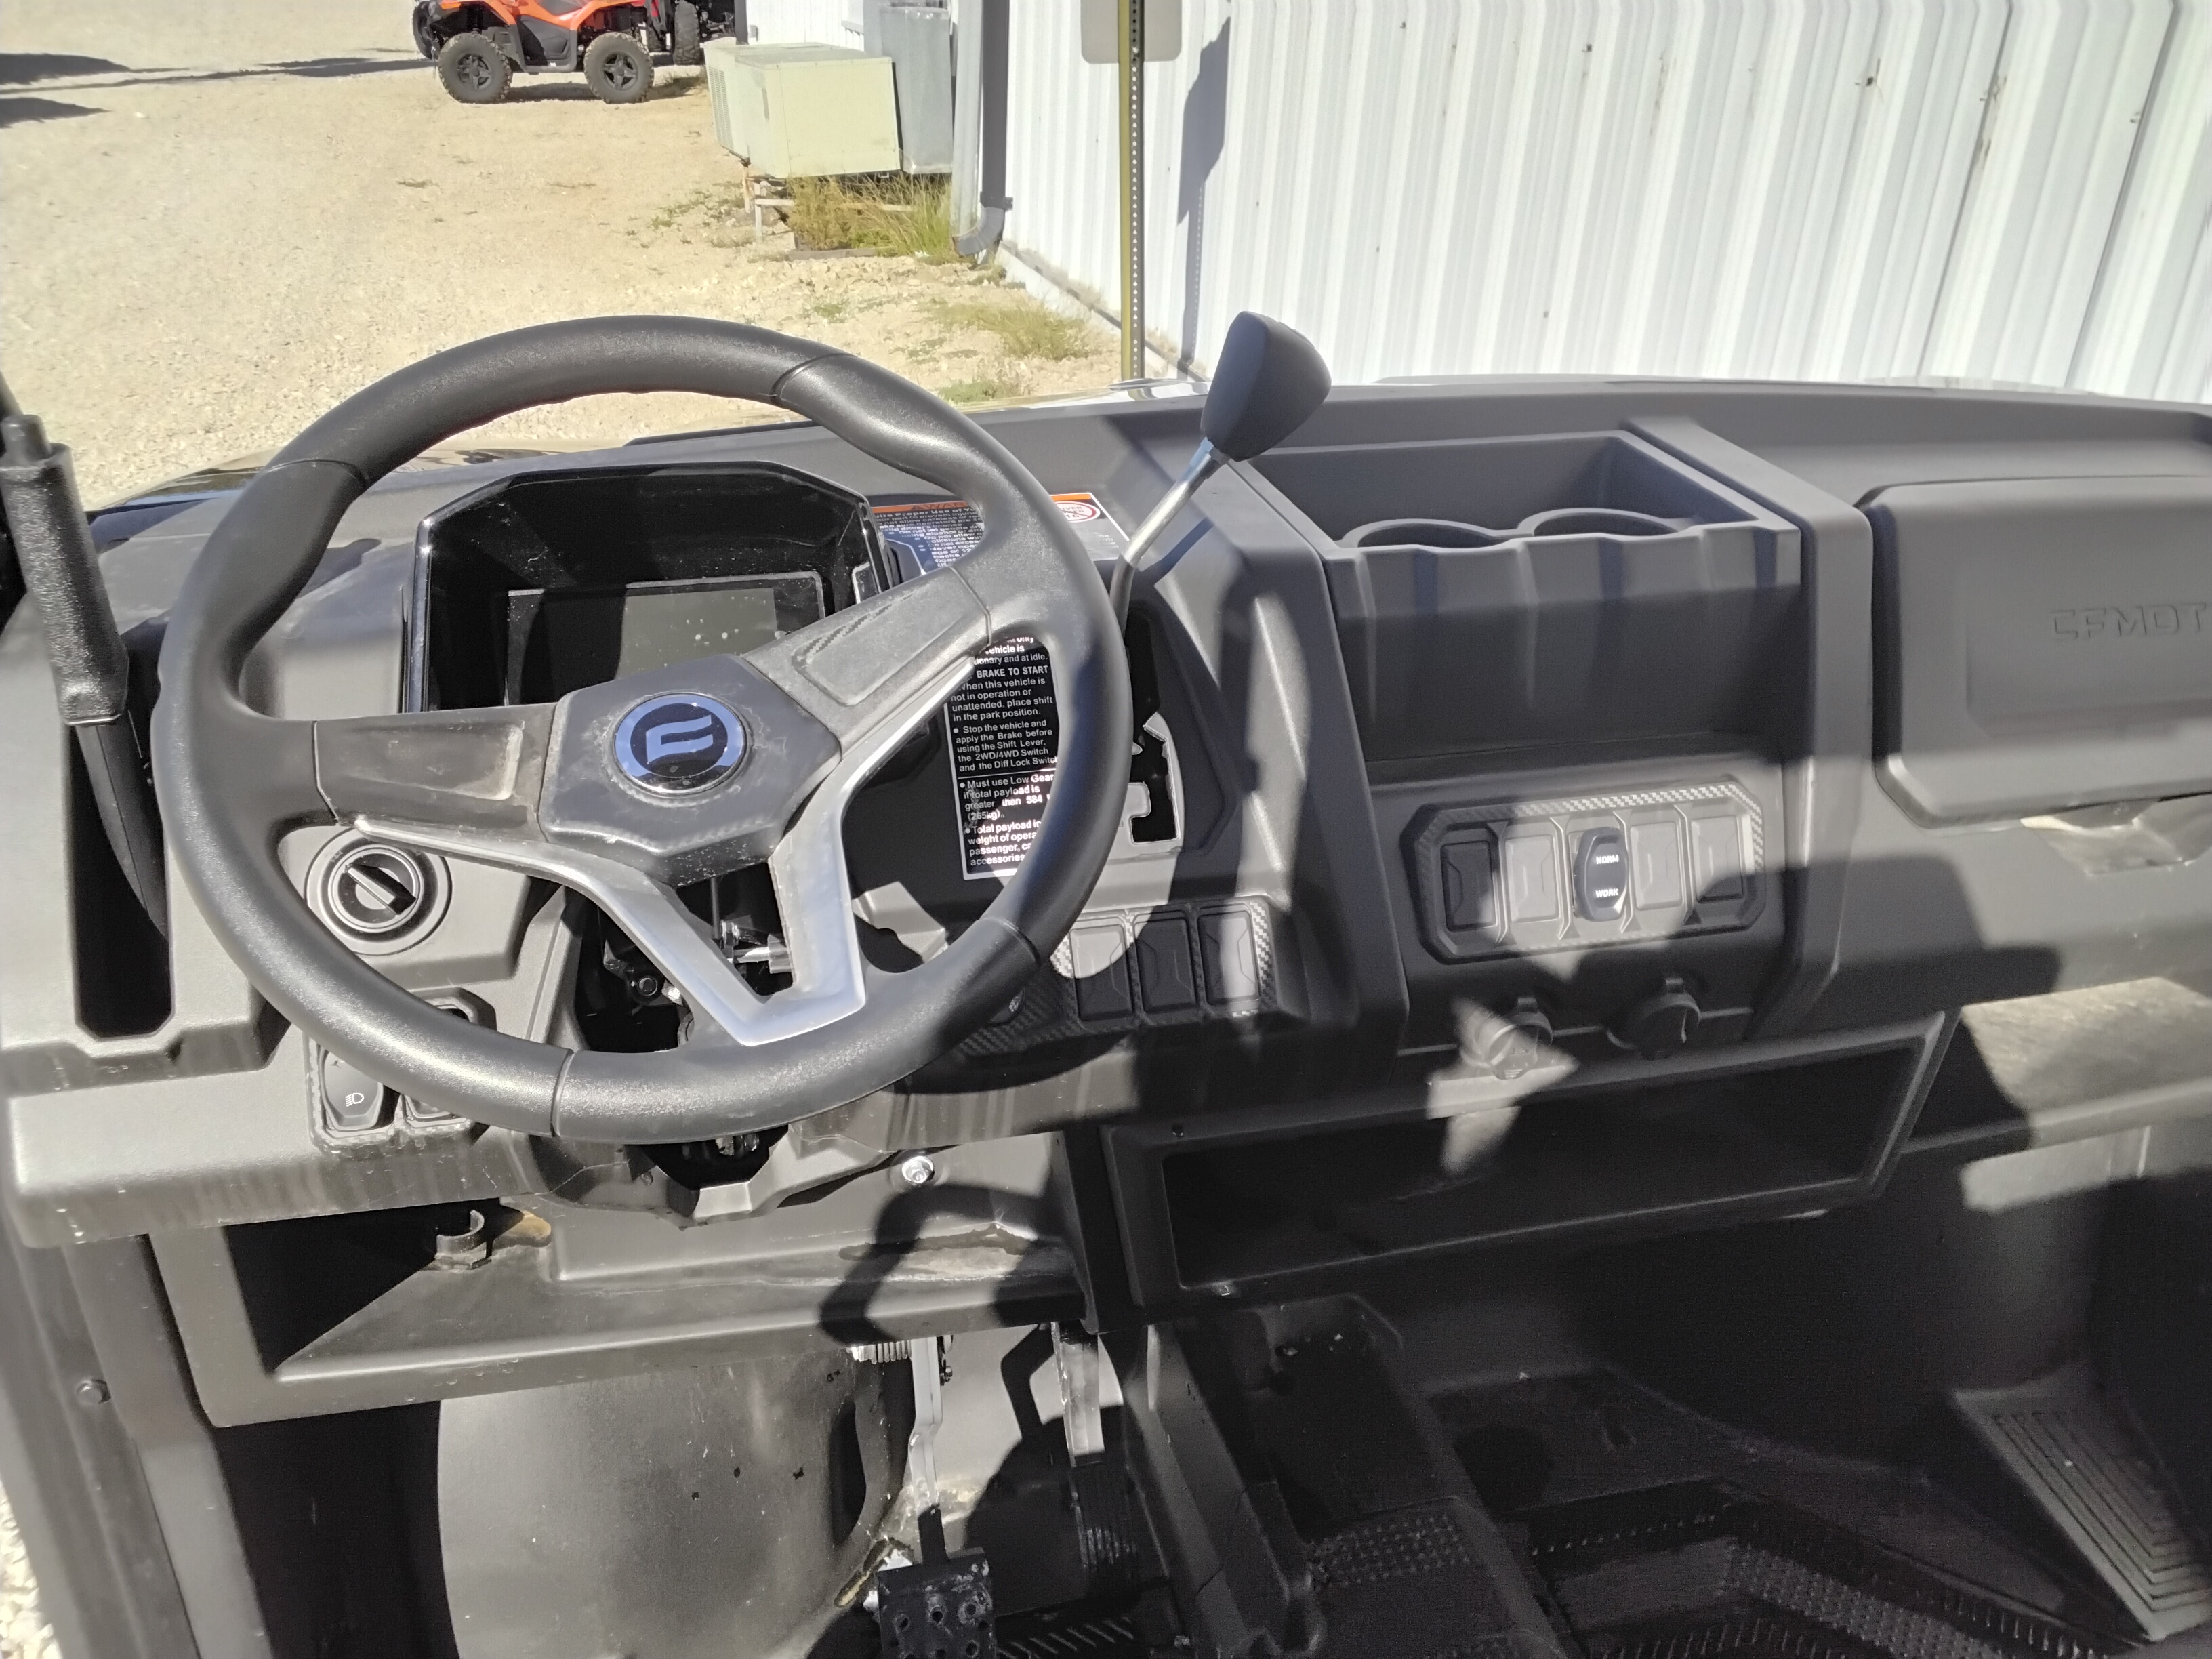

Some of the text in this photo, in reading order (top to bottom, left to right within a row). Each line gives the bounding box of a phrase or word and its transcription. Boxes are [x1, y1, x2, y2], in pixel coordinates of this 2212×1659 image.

[1017, 644, 1025, 653] is
[1004, 655, 1019, 663] and
[1031, 653, 1048, 661] idle.
[977, 665, 1048, 678] BRAKE TO START
[985, 680, 1002, 689] this
[1003, 678, 1036, 687] vehicle
[951, 693, 966, 702] not
[966, 691, 976, 701] in
[977, 689, 1021, 701] operation
[1006, 698, 1032, 708] place
[1033, 696, 1053, 705] shift
[963, 712, 978, 721] the
[980, 710, 1001, 721] park
[1002, 708, 1041, 719] position.
[963, 725, 983, 735] Stop
[984, 724, 998, 732] the
[999, 720, 1029, 731] vehicle
[956, 729, 1053, 745] apply the Brake before
[956, 739, 1046, 754] using the Shift Lever.
[958, 747, 1049, 763] the 2WD/4WD Switch
[959, 764, 976, 772] and
[979, 761, 993, 770] the
[994, 760, 1010, 769] Diff
[1010, 758, 1031, 767] Lock
[967, 774, 1054, 789] Must use Low Gear
[964, 784, 1040, 800] if total payload is
[964, 800, 996, 812] greater
[1002, 798, 1021, 807] than
[1026, 794, 1043, 804] 584
[972, 823, 995, 834] Total
[996, 819, 1032, 834] payload
[968, 834, 999, 846] weight
[1000, 832, 1010, 842] of
[1595, 854, 1620, 865] NORM
[1595, 888, 1619, 898] WORK
